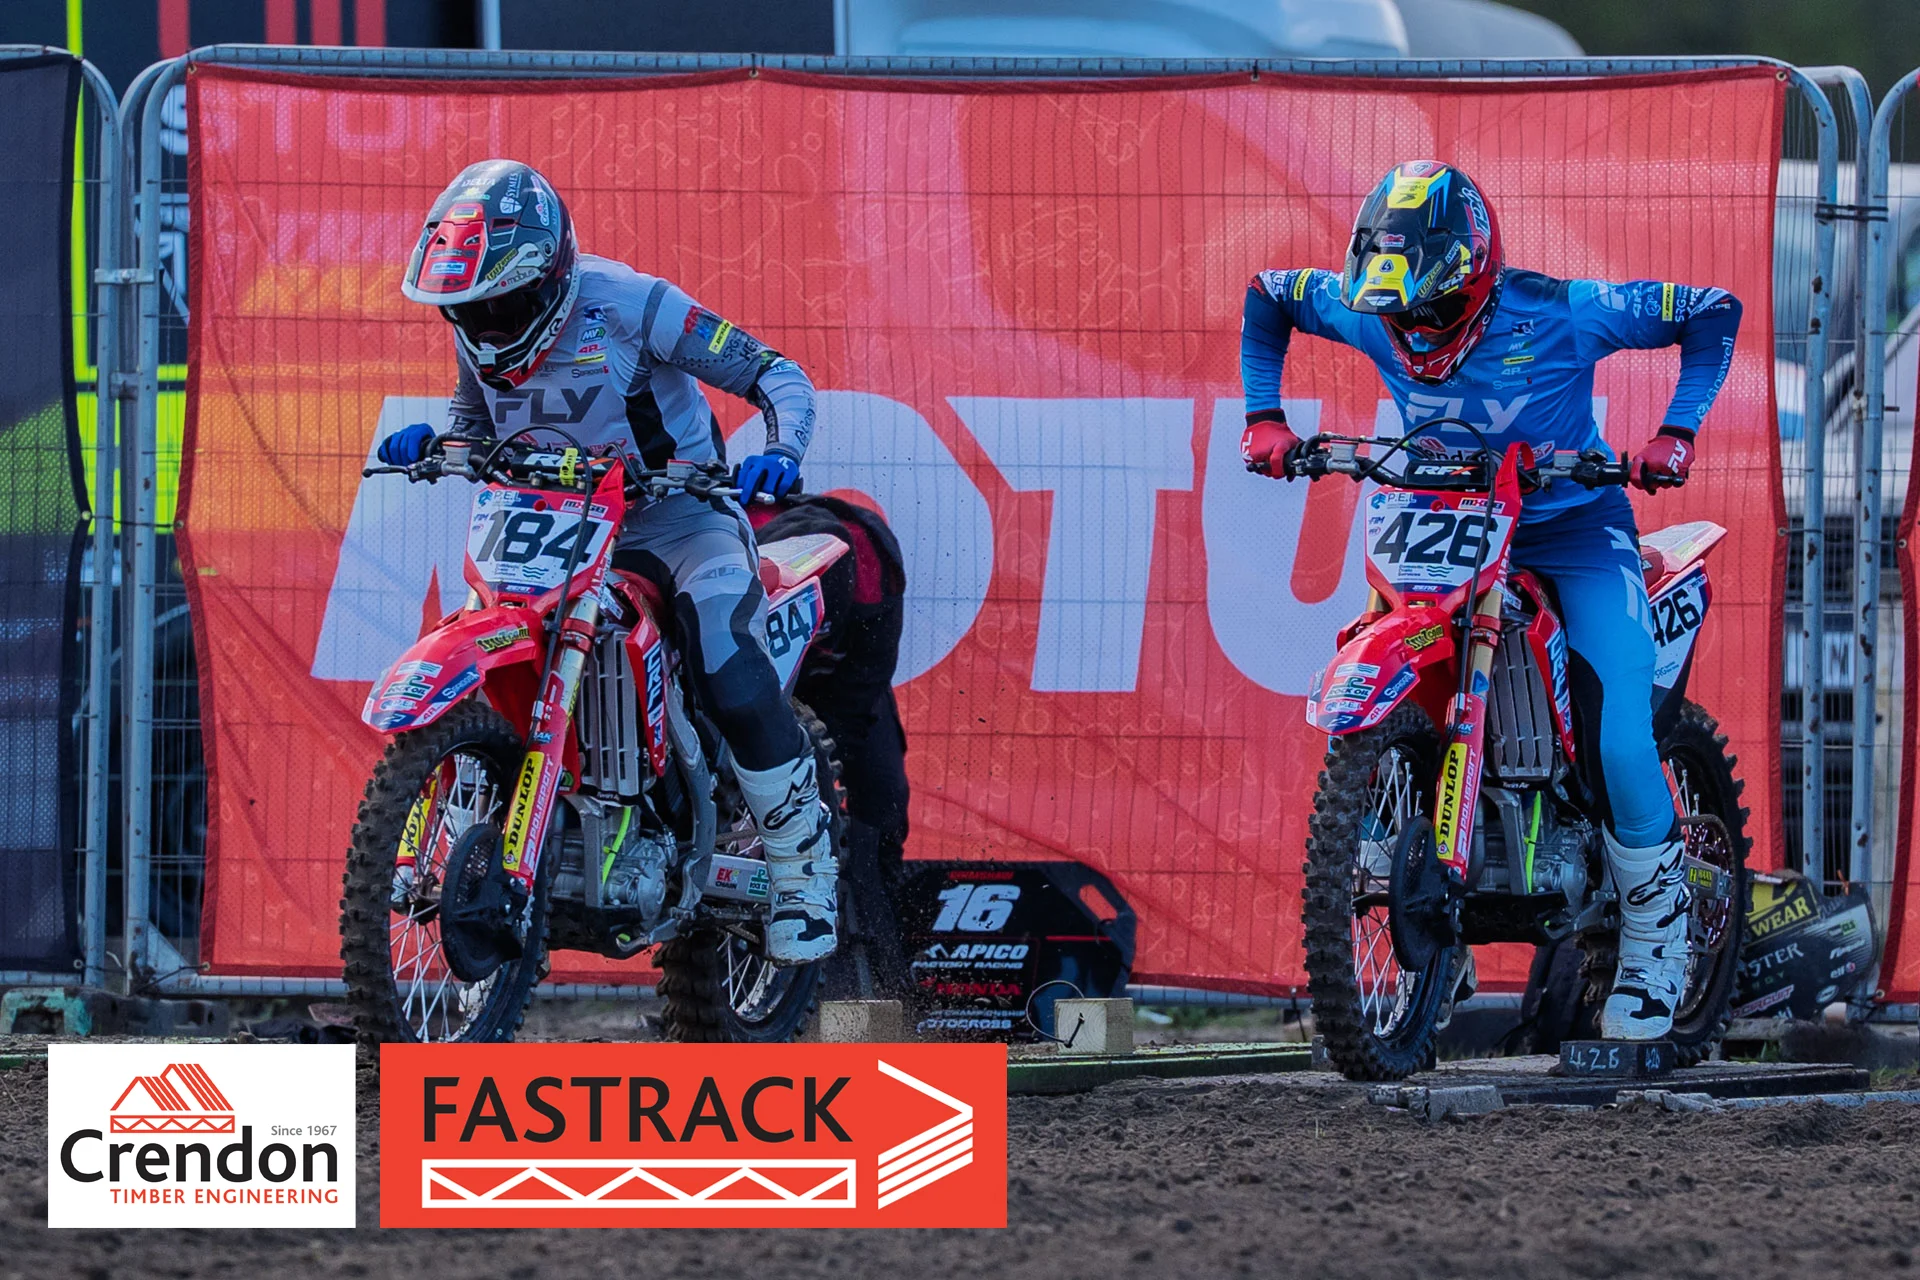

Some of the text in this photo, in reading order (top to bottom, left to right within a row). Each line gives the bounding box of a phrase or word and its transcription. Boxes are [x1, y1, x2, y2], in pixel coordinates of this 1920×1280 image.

[495, 384, 604, 424] FLY
[1405, 391, 1534, 434] FLY
[312, 394, 1608, 693] OTU
[476, 510, 601, 570] 184
[1373, 512, 1498, 568] 426
[766, 602, 812, 658] 84
[1355, 688, 1369, 697] OIL
[510, 757, 534, 848] DUNLOP
[1441, 749, 1460, 839] DUNLOP
[931, 884, 1021, 932] 16
[1751, 896, 1812, 937] WEAR
[912, 961, 1024, 969] FACTORY RACING
[951, 944, 1030, 960] APICO
[1748, 942, 1805, 977] STER
[935, 983, 1023, 996] HONDA
